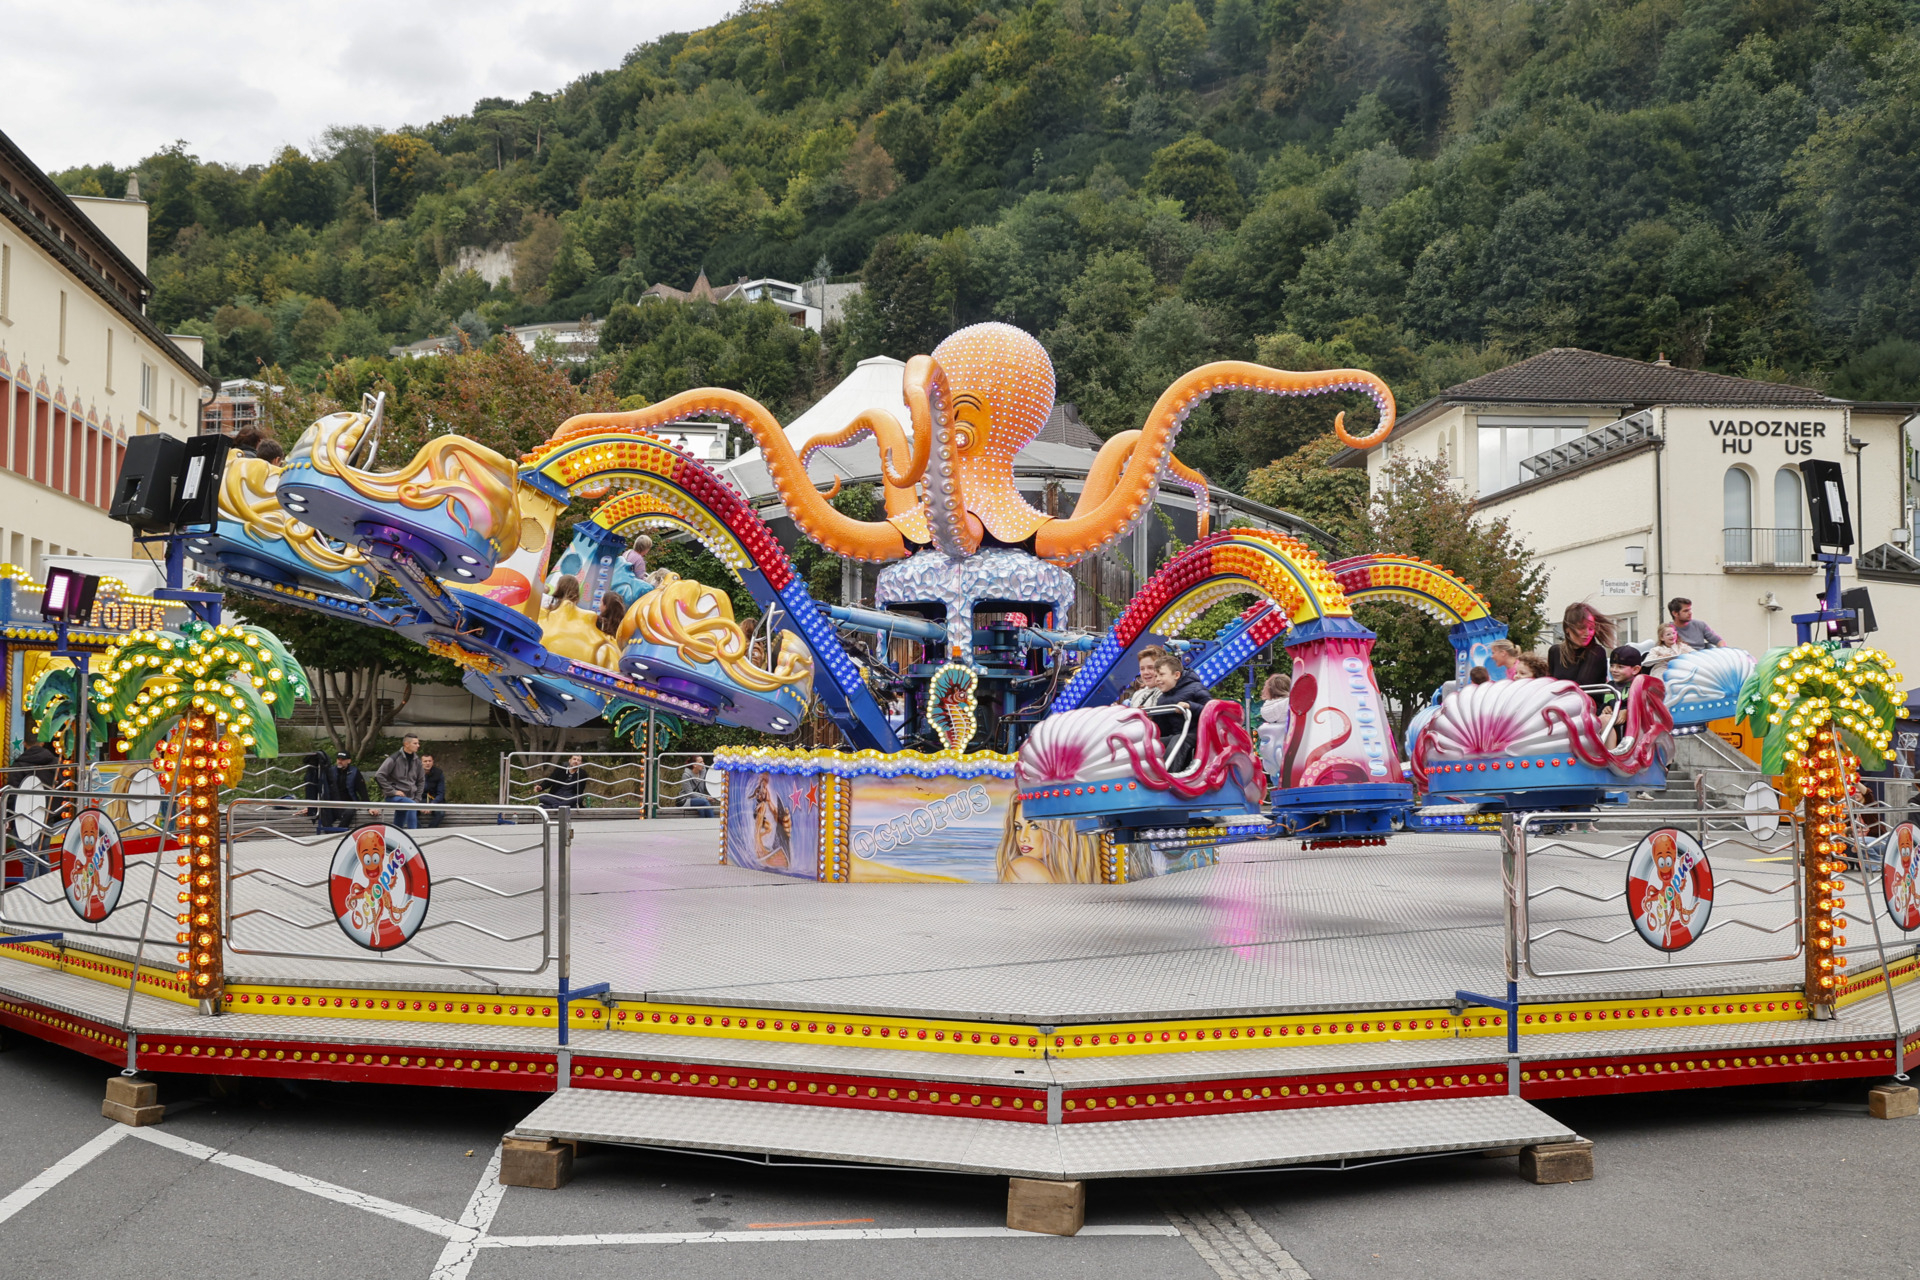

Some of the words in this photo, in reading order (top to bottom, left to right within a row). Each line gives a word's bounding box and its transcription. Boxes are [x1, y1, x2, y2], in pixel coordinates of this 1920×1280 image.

[1709, 420, 1826, 438] VADOZNER
[1722, 438, 1753, 454] HU
[1785, 440, 1812, 455] US
[89, 599, 166, 632] TOPUS
[592, 555, 613, 616] OCTOP
[1342, 657, 1388, 777] OCTOPUS
[852, 784, 991, 860] OCTOPUS
[73, 833, 112, 902] Octopus
[351, 848, 406, 931] Octopus
[1646, 852, 1695, 932] Octopus
